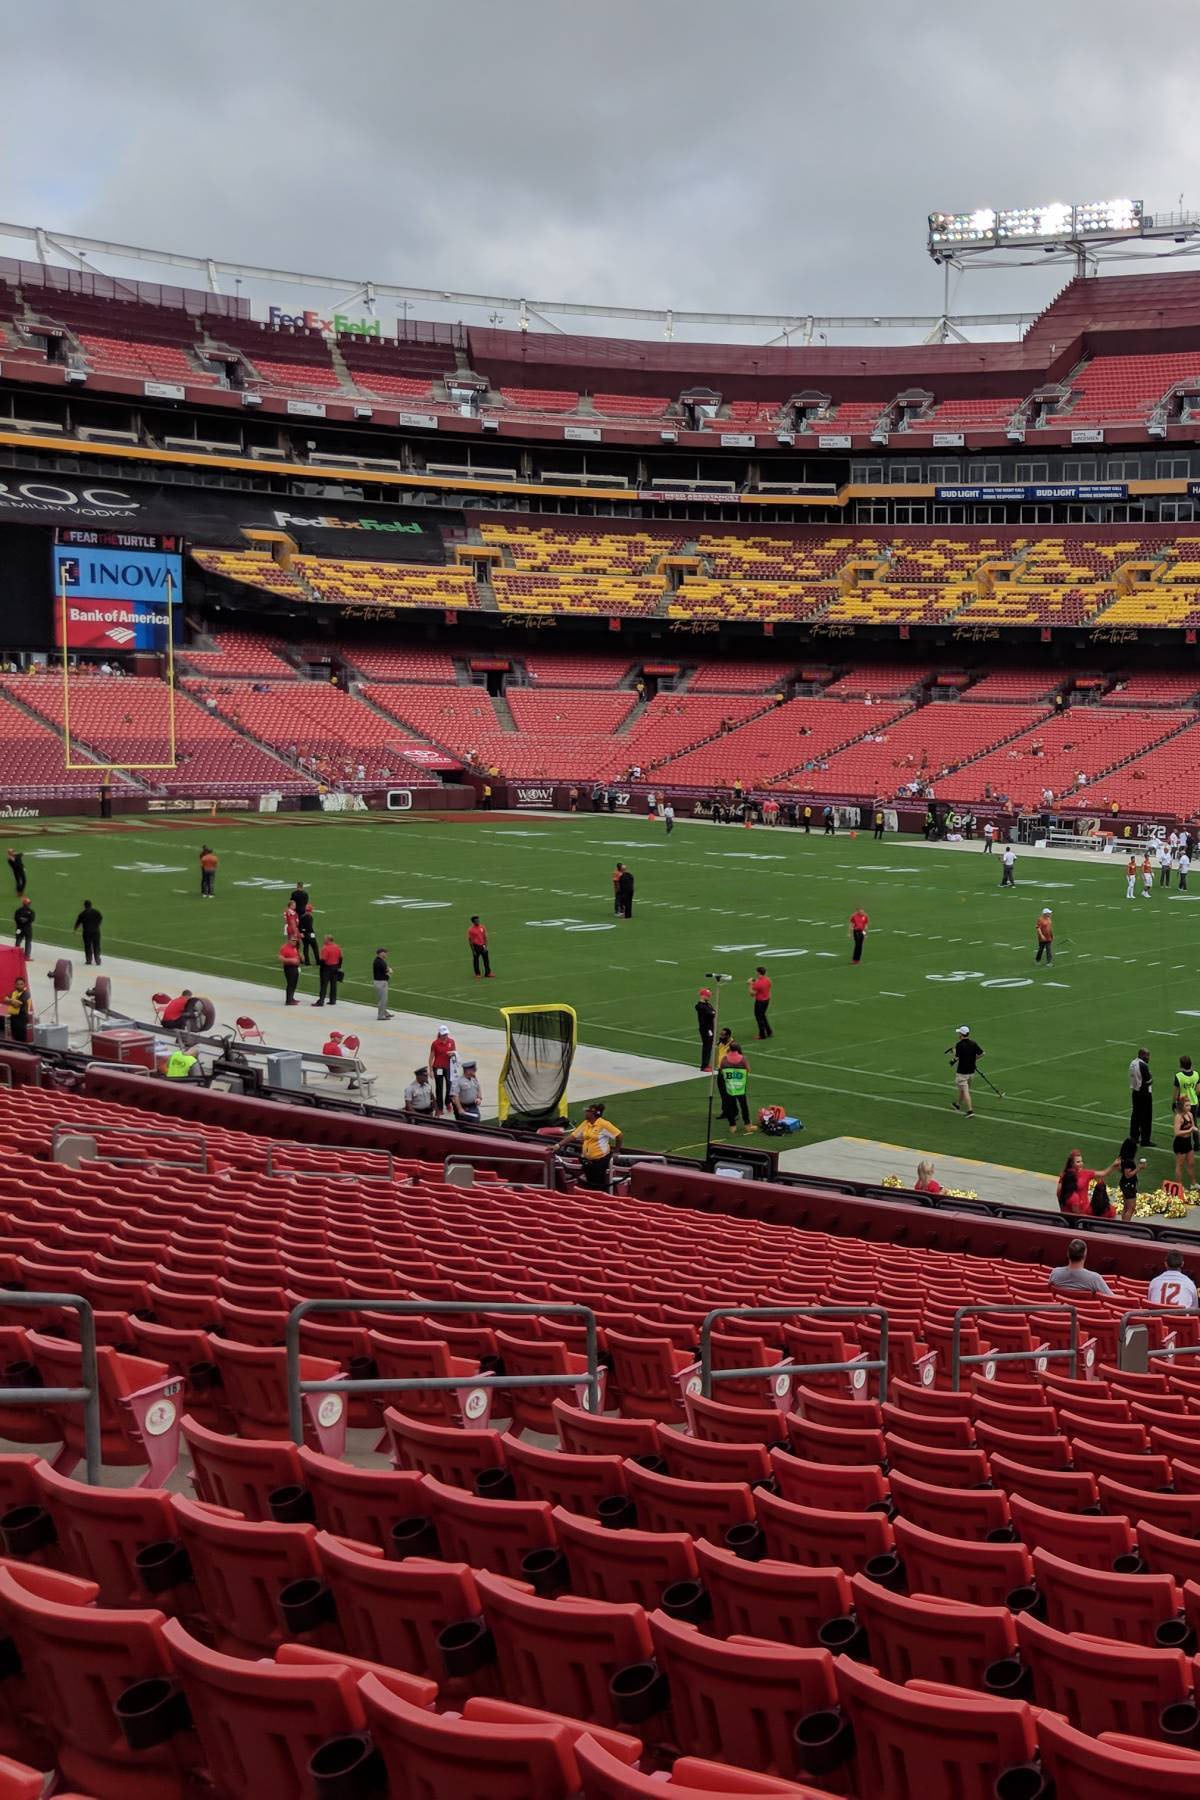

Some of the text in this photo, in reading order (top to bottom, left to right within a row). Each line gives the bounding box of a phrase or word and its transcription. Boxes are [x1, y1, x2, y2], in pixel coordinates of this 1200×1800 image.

[269, 306, 380, 337] FedExField
[940, 490, 980, 498] BUD LIGHT
[1036, 489, 1053, 497] BUD
[69, 507, 137, 517] VODKA
[274, 511, 423, 534] FedExField
[90, 563, 178, 588] INOVA
[70, 608, 170, 626] Bank of America
[518, 788, 553, 800] WOW!
[604, 791, 630, 805] 137
[925, 970, 1034, 988] 30
[1163, 1182, 1180, 1197] 10
[1159, 1281, 1182, 1305] 12
